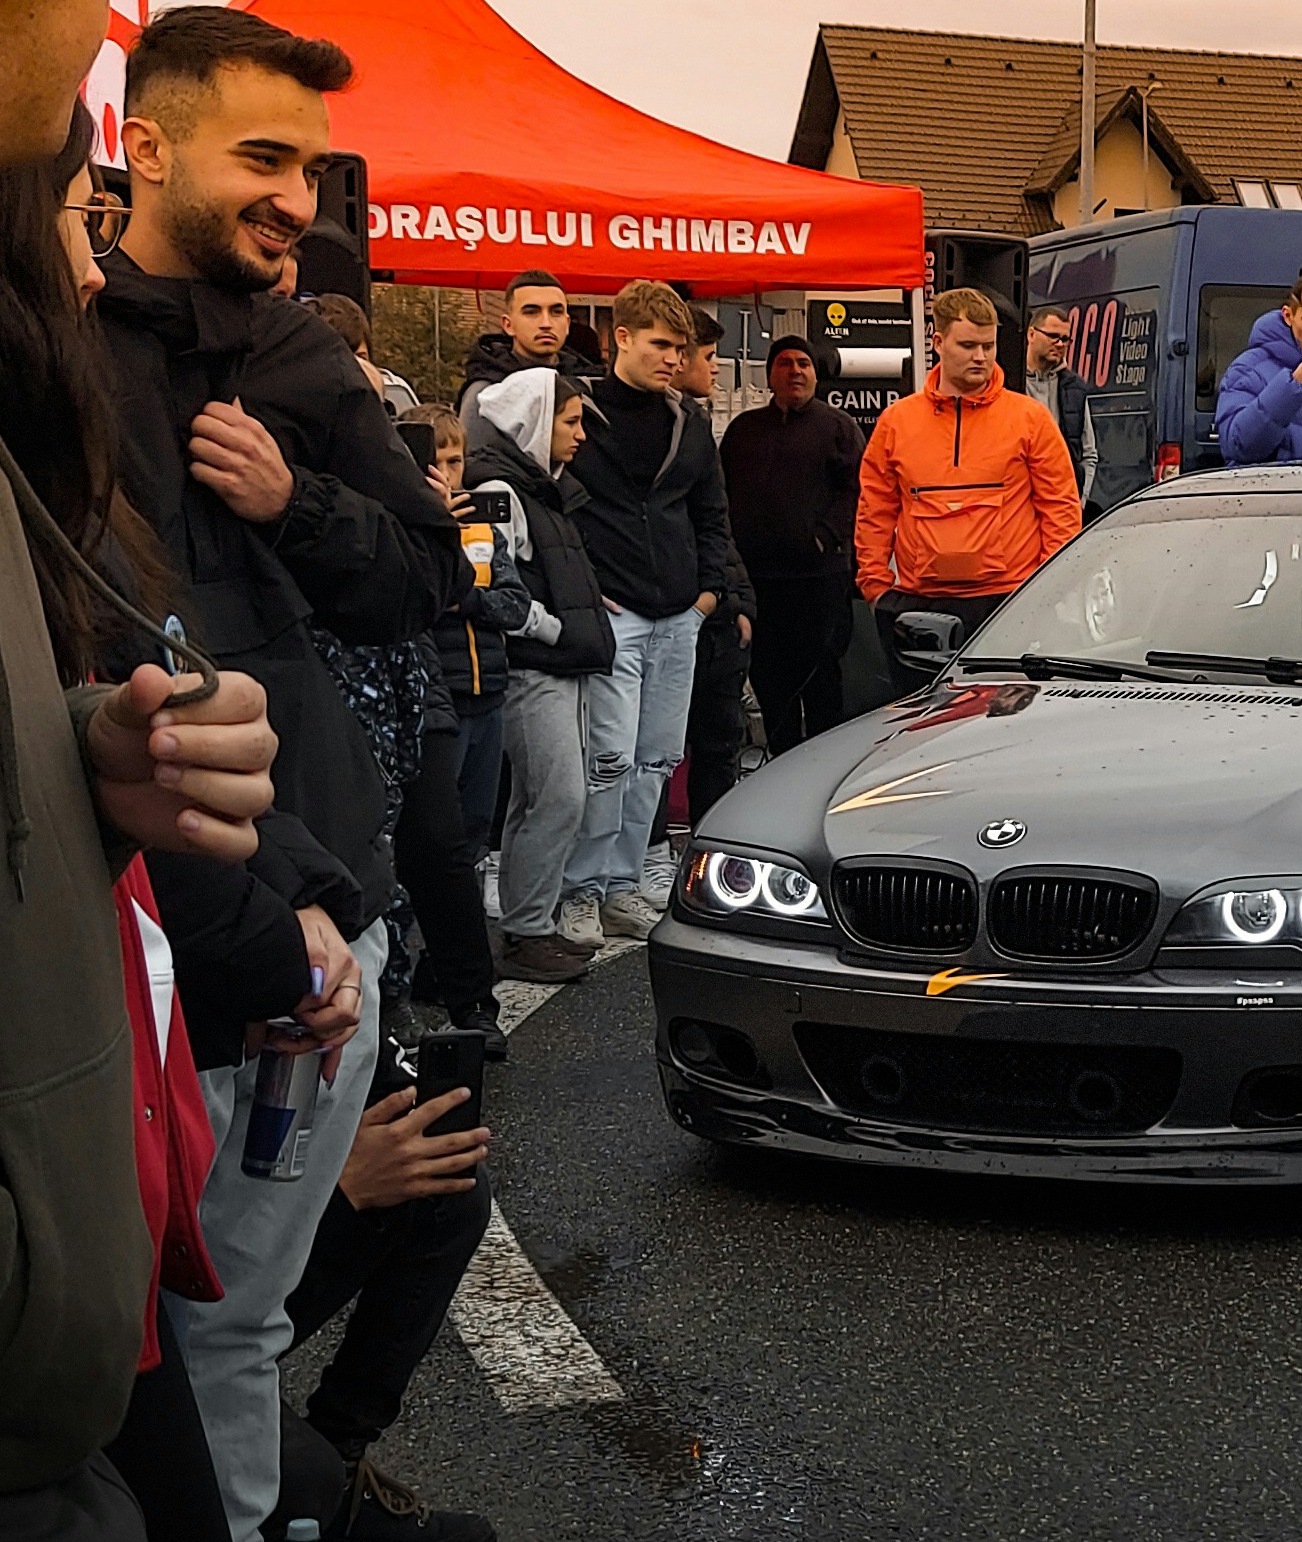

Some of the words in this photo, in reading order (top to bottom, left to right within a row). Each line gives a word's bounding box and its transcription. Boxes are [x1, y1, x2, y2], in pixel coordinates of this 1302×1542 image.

[608, 214, 812, 255] GHIMBAV
[1121, 316, 1151, 340] Light
[1067, 300, 1117, 387] OCO
[1119, 341, 1148, 362] Video
[1116, 364, 1146, 387] Stage
[827, 390, 881, 409] GAIN
